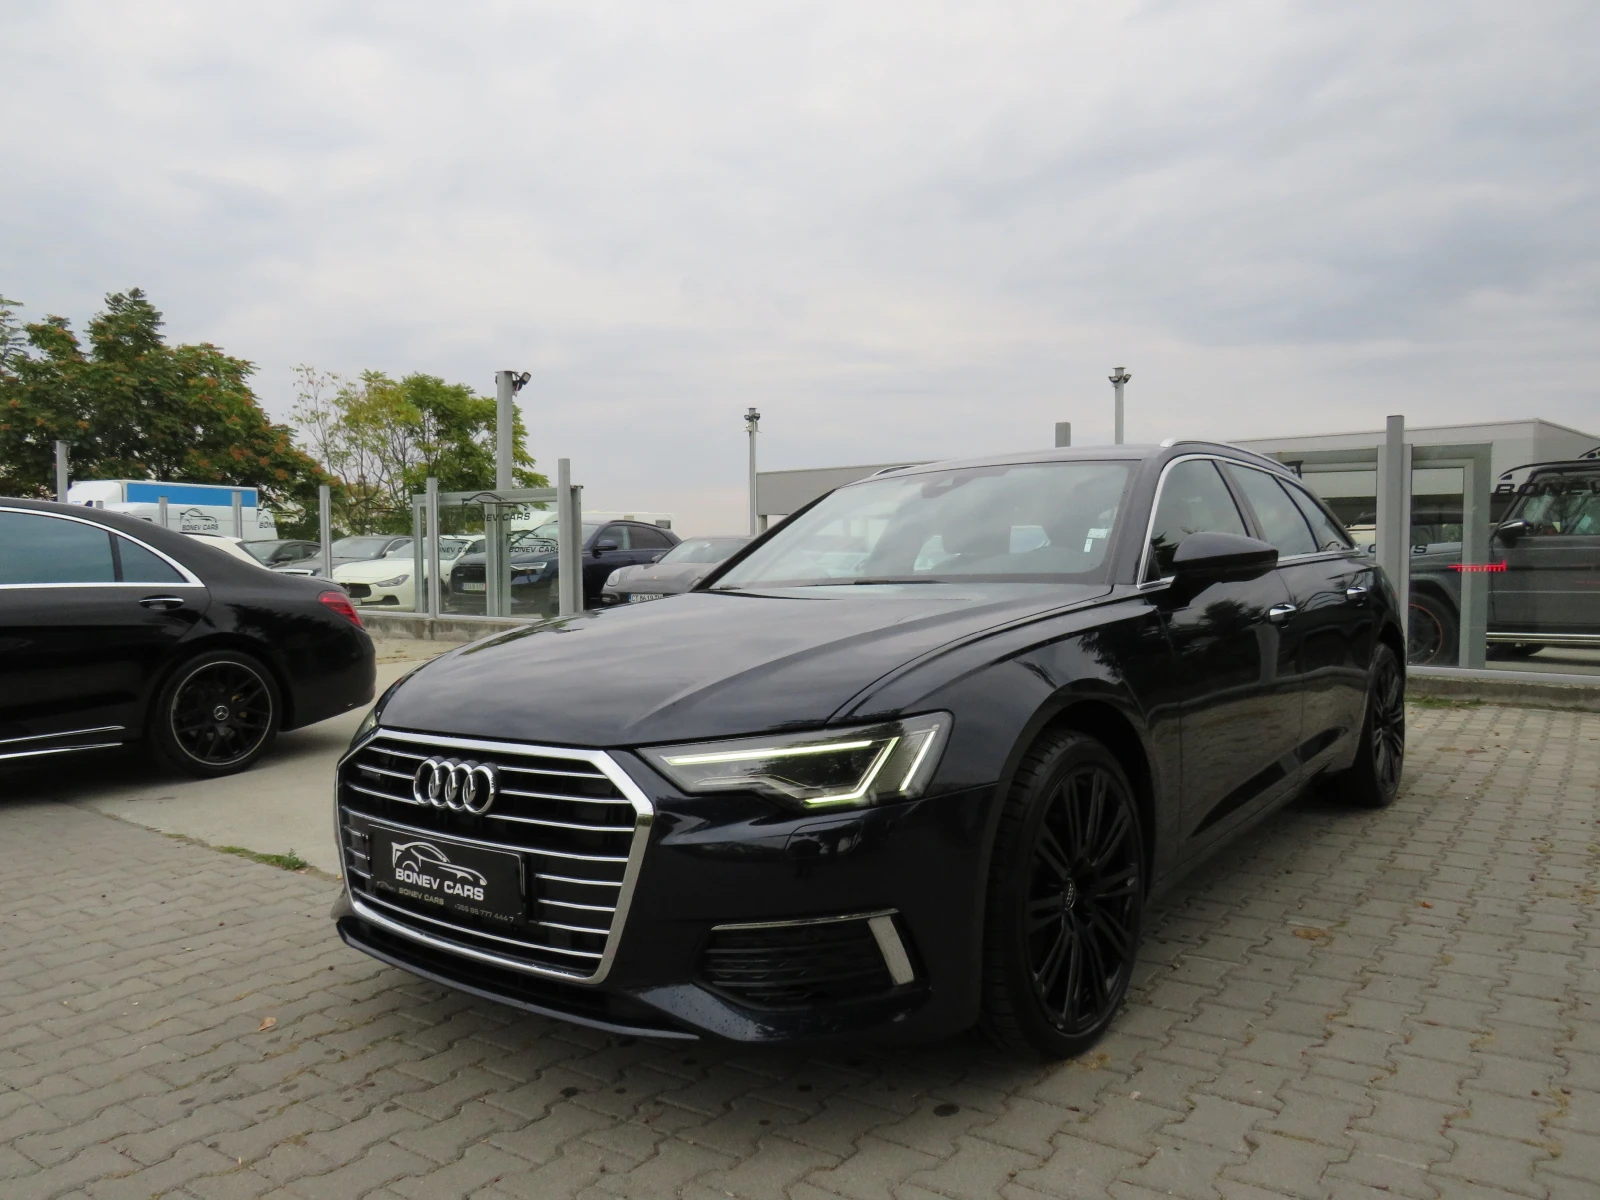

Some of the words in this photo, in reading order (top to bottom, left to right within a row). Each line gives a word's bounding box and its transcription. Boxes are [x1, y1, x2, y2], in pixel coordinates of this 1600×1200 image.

[503, 512, 531, 521] CARS
[395, 867, 440, 890] BONEV
[443, 880, 485, 901] CARS
[398, 887, 422, 900] BONEV
[423, 895, 445, 906] CARS
